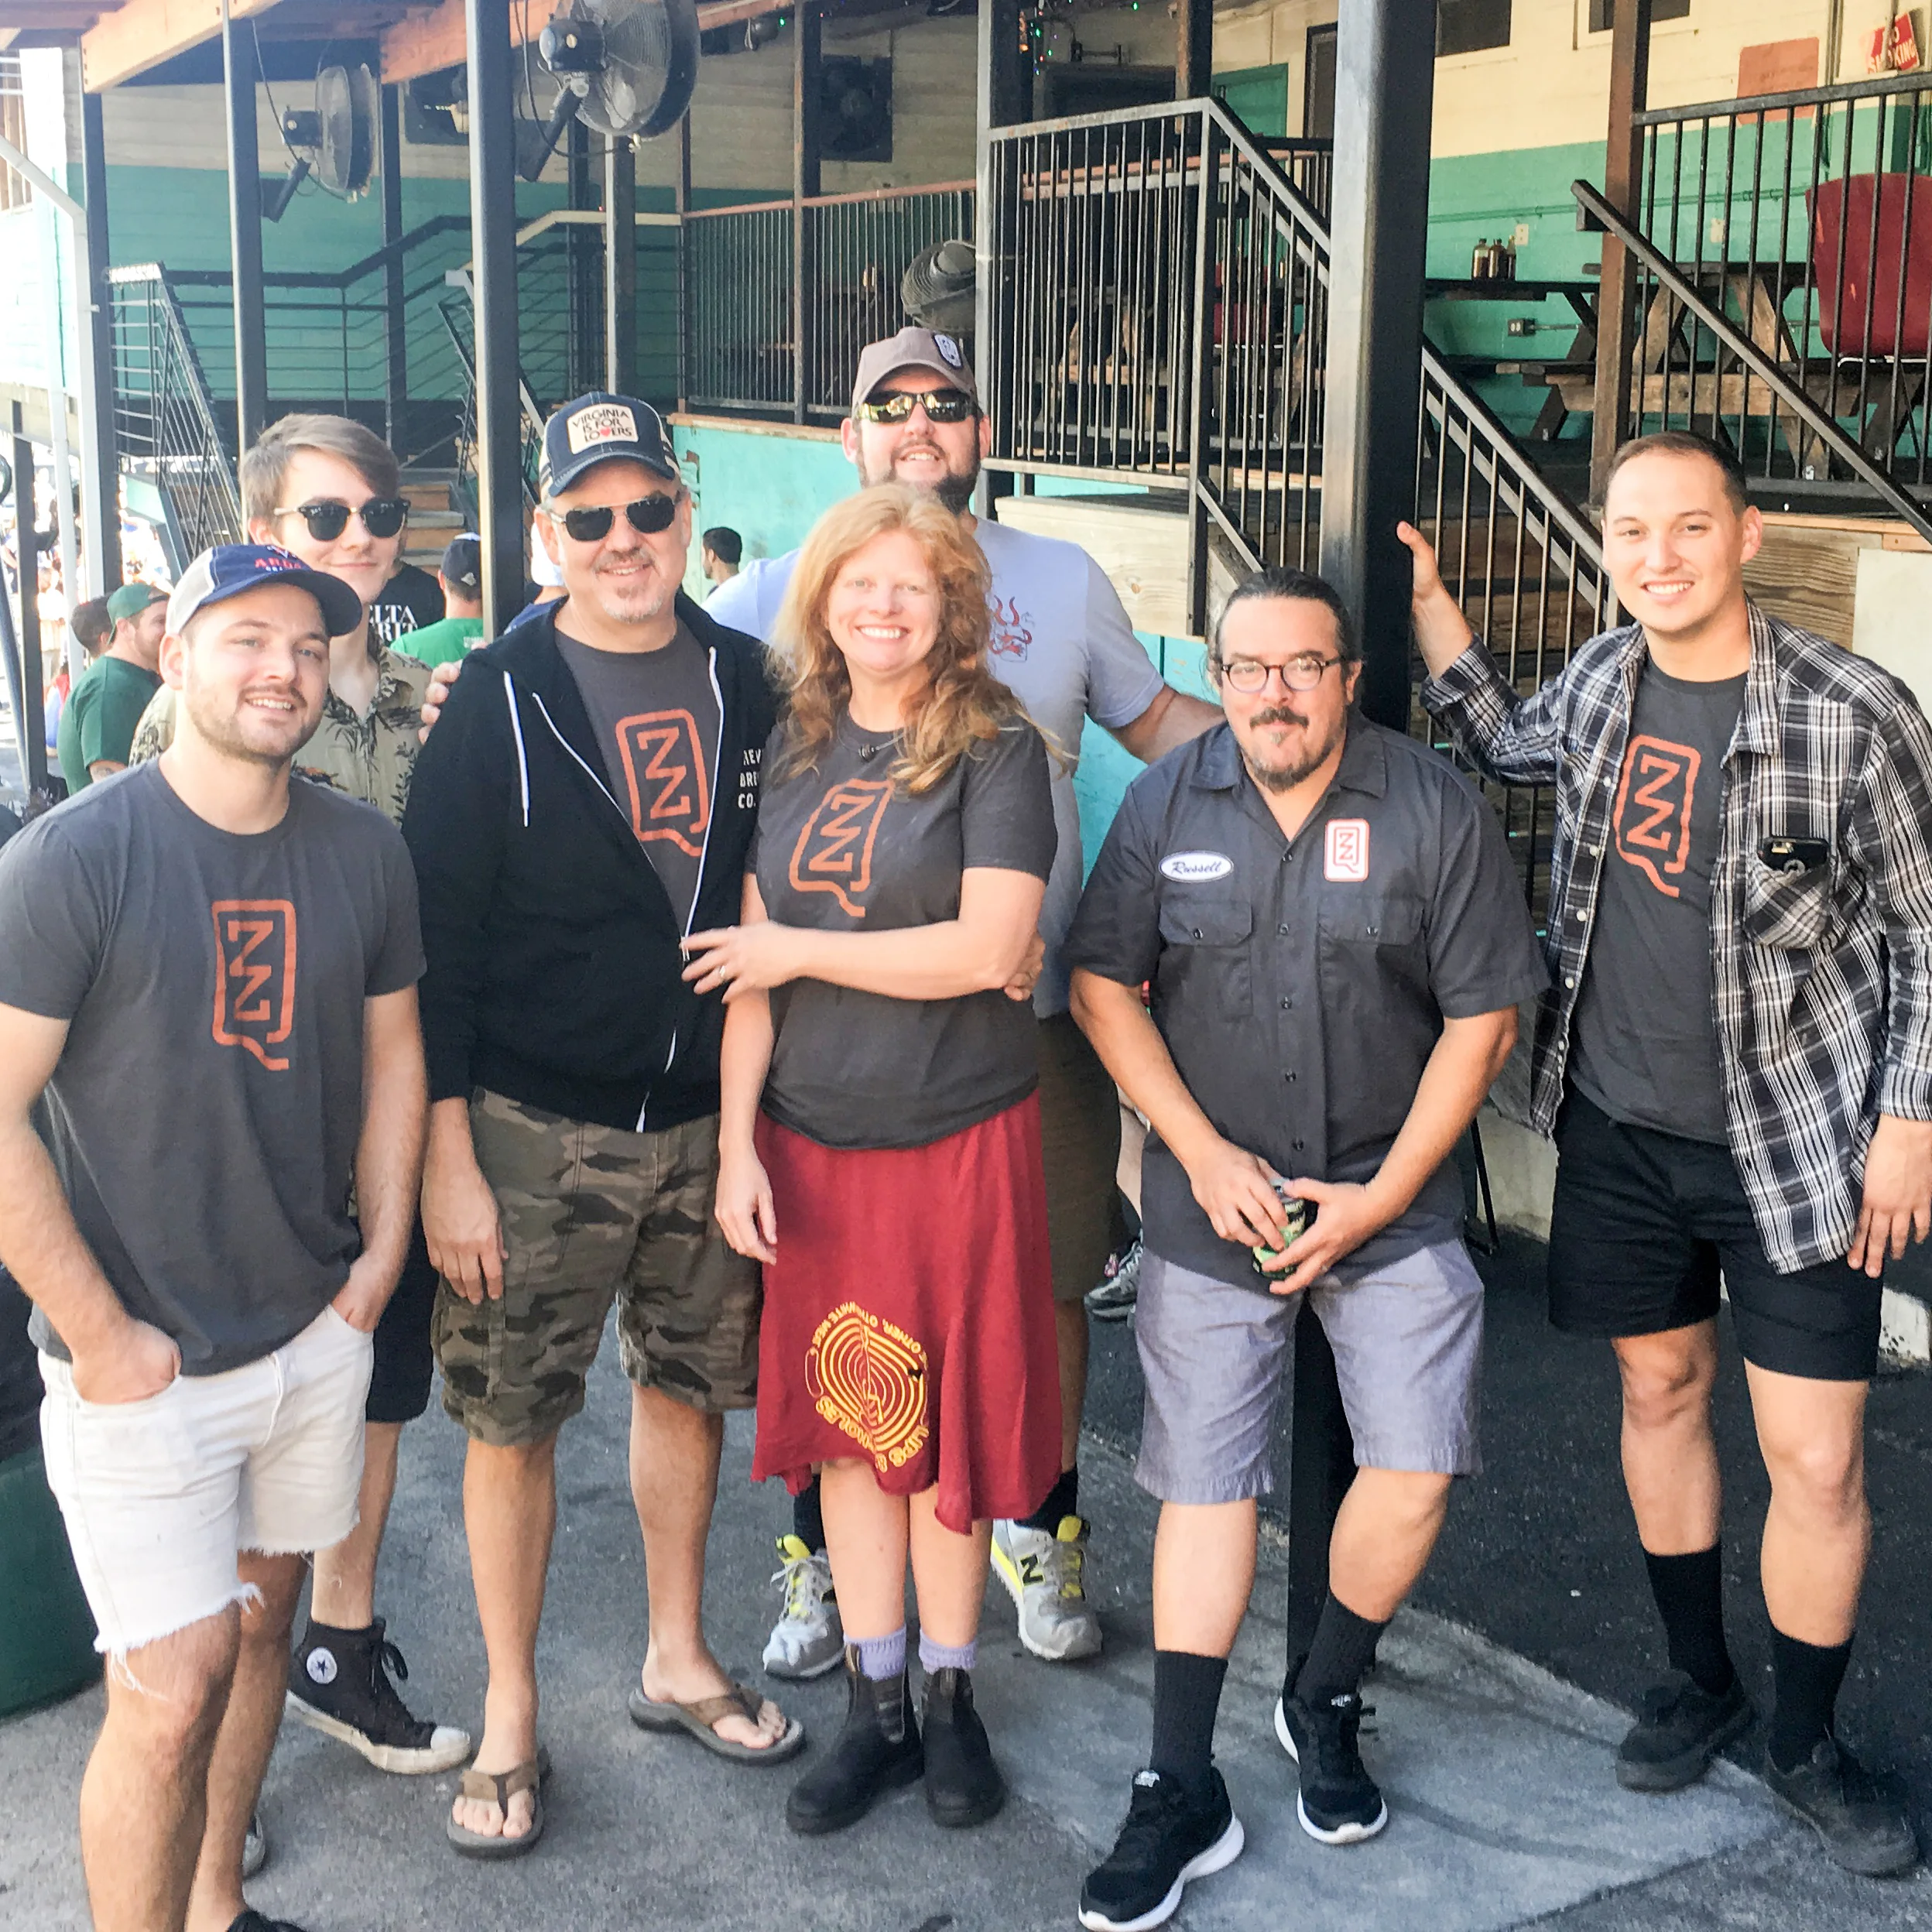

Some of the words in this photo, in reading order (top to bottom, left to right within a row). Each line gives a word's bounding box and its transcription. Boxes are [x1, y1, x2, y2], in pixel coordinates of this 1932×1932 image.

[572, 409, 629, 428] VIRGINIA
[583, 422, 593, 433] IS
[595, 418, 622, 430] FOR
[738, 793, 756, 809] CO.
[1170, 860, 1221, 875] Russell
